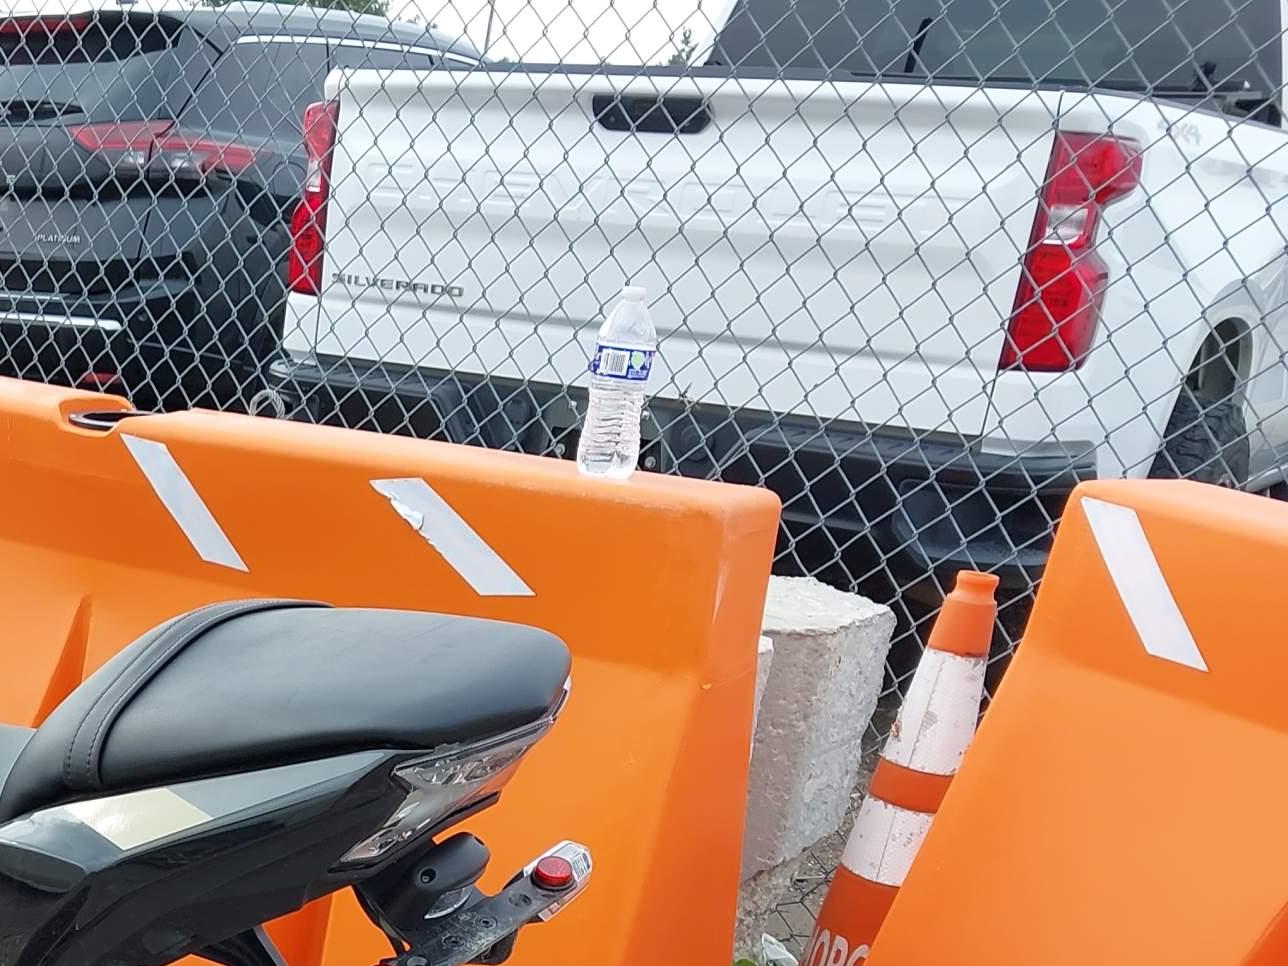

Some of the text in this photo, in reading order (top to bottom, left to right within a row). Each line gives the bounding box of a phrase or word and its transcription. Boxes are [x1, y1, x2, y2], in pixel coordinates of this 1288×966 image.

[362, 160, 982, 240] CHEVROLET
[36, 234, 81, 244] PLATINUM
[331, 272, 465, 297] SILVERADO
